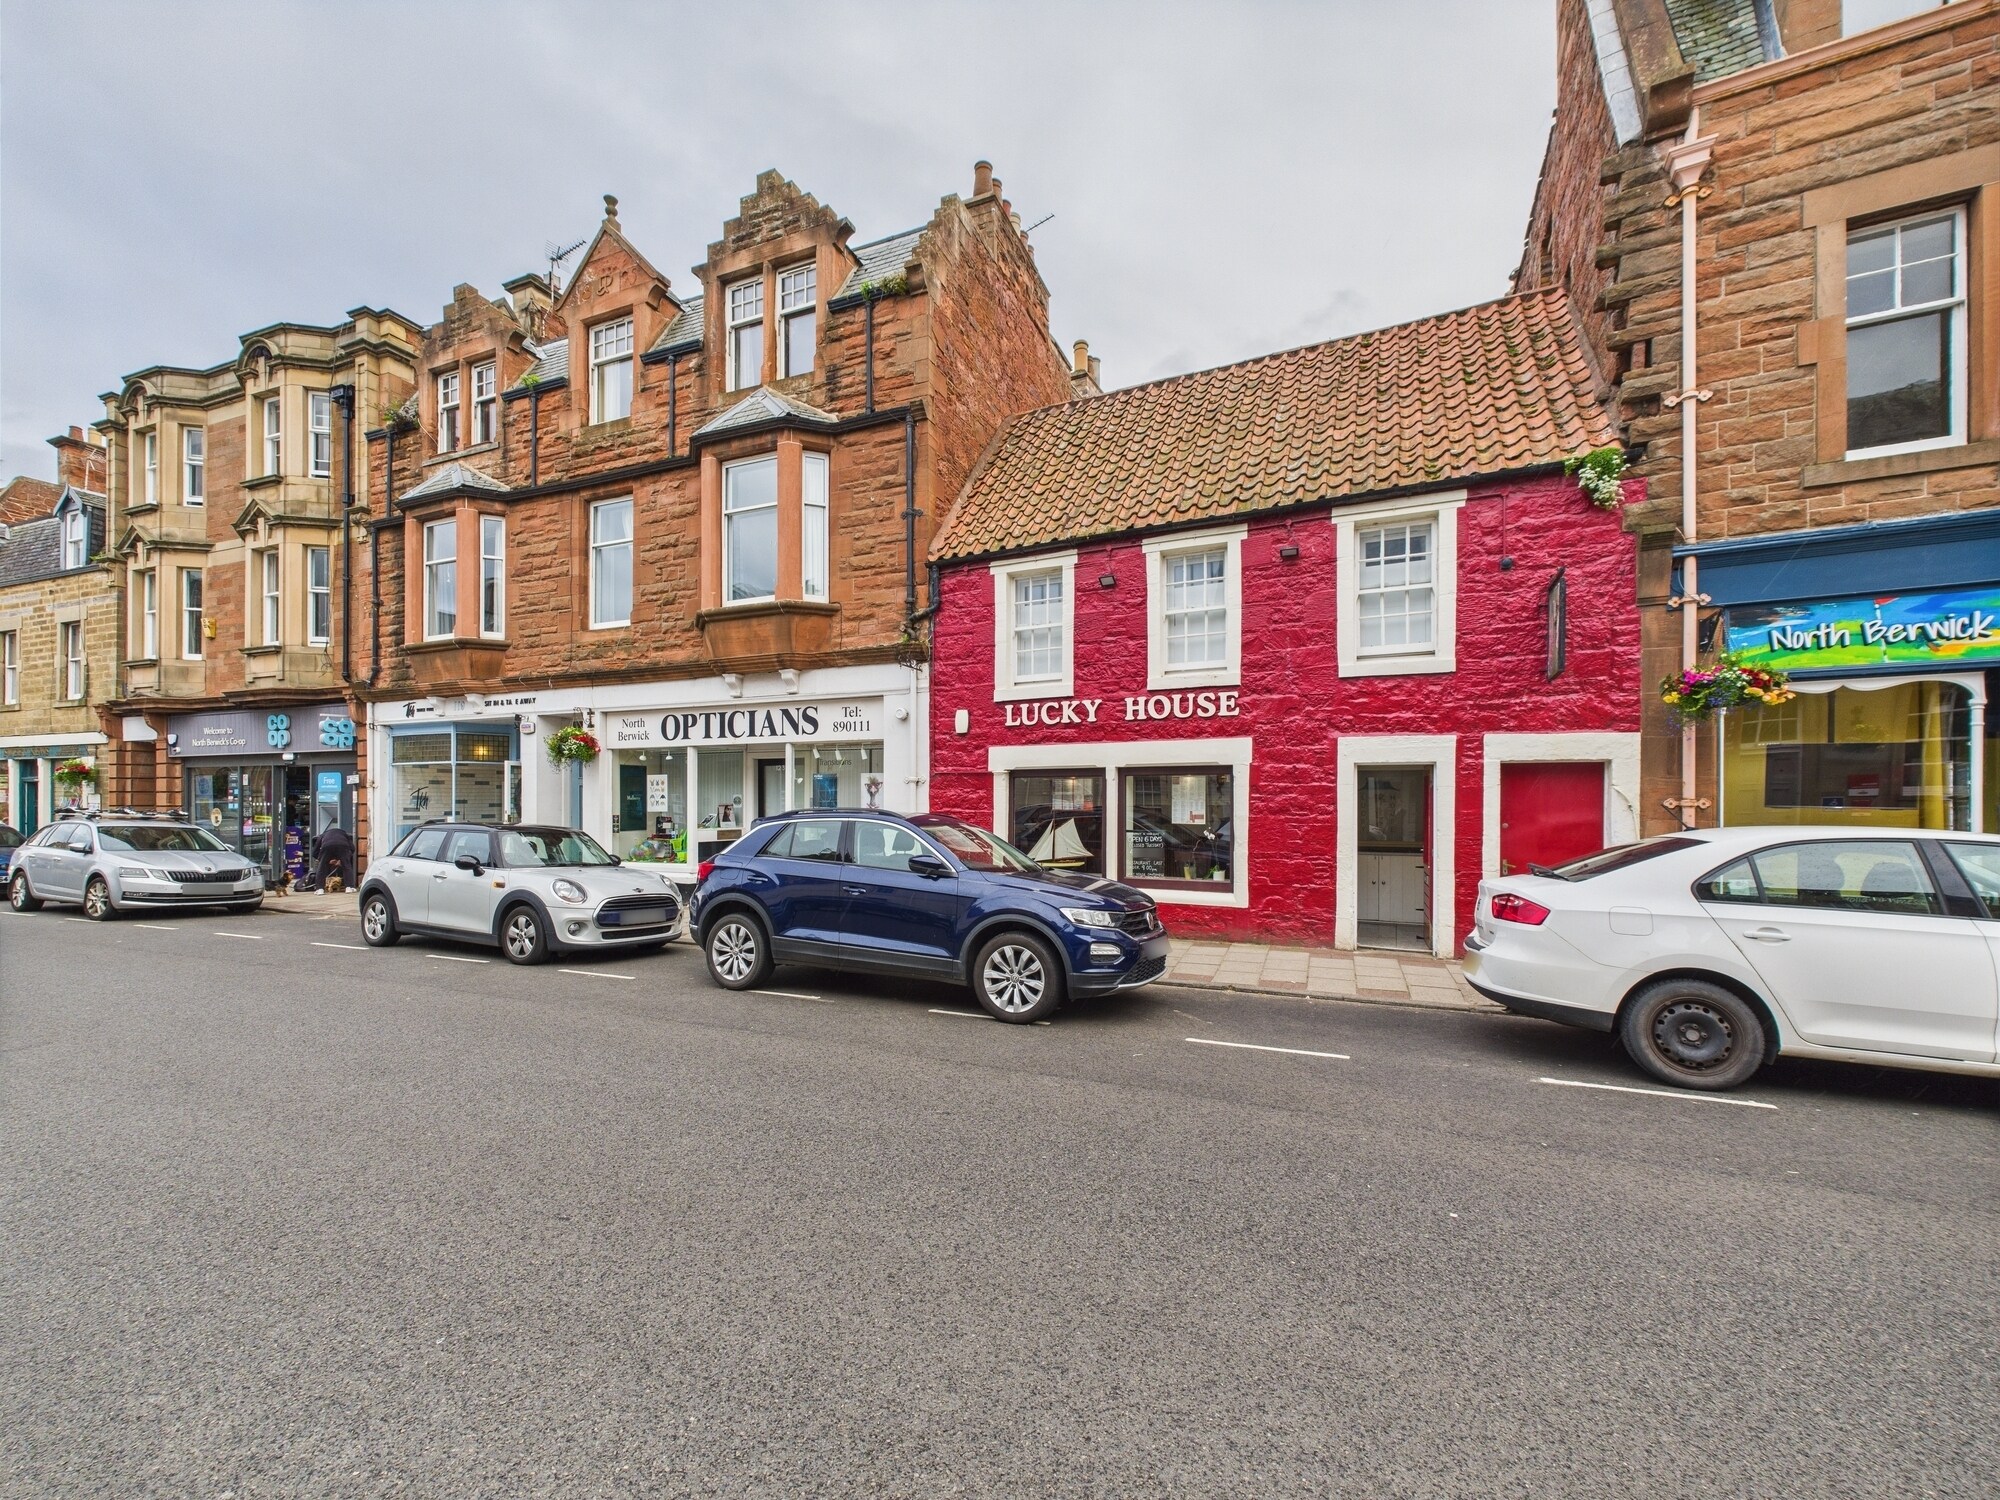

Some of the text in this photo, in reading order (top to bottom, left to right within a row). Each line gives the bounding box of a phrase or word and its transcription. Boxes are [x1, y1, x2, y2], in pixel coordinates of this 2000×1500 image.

[1768, 610, 1995, 651] North Berwick
[842, 706, 862, 718] Tel:
[1005, 691, 1240, 727] LUCKY HOUSE
[622, 717, 645, 728] North
[661, 706, 819, 741] OPTICIANS
[832, 720, 870, 732] 890111
[203, 727, 227, 735] Welcome
[618, 730, 650, 741] Berwick
[192, 737, 247, 747] North Berwick's Co-op
[323, 776, 336, 785] Free
